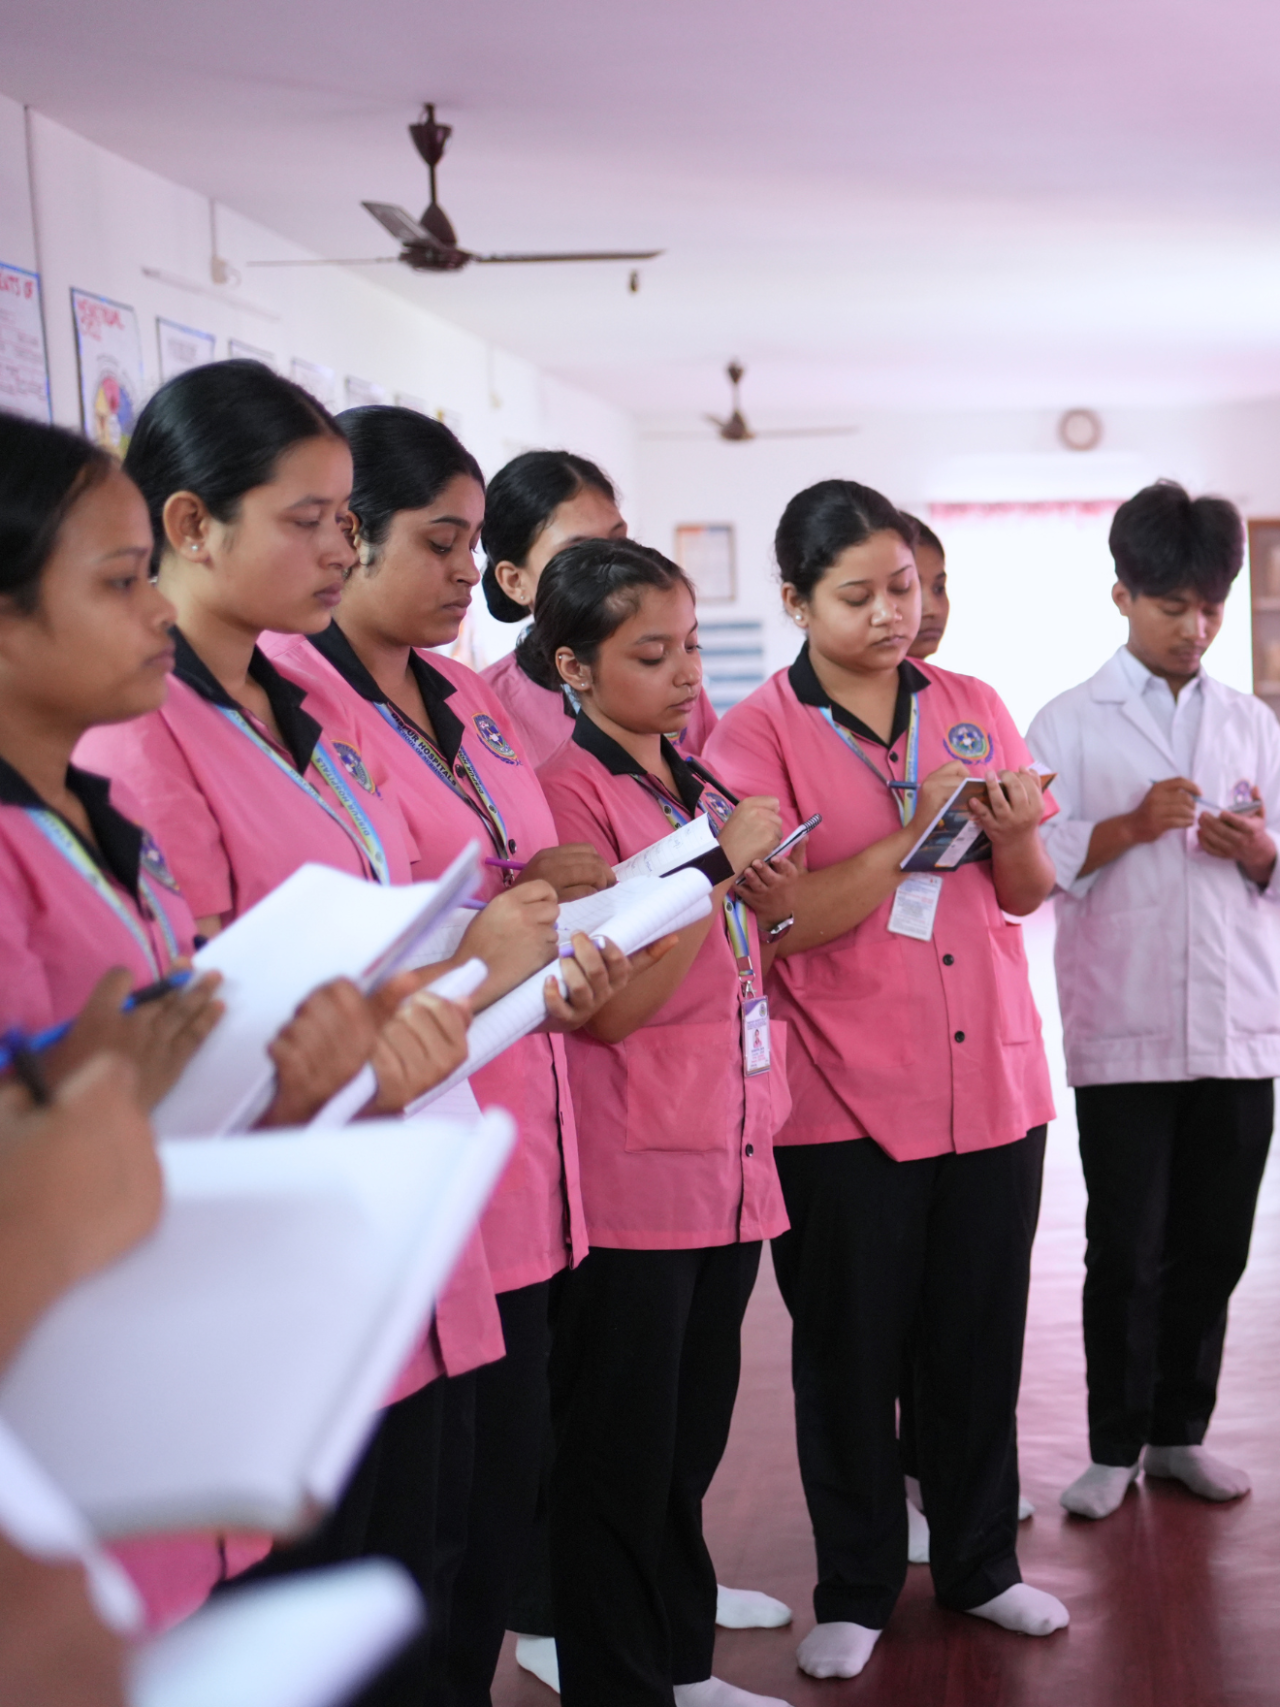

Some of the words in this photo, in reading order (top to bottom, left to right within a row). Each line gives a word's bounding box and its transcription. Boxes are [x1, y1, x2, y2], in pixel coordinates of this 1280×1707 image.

[316, 757, 350, 803] HOSPITALS
[418, 742, 457, 787] HOSPITALS
[347, 804, 371, 836] DISPUR
